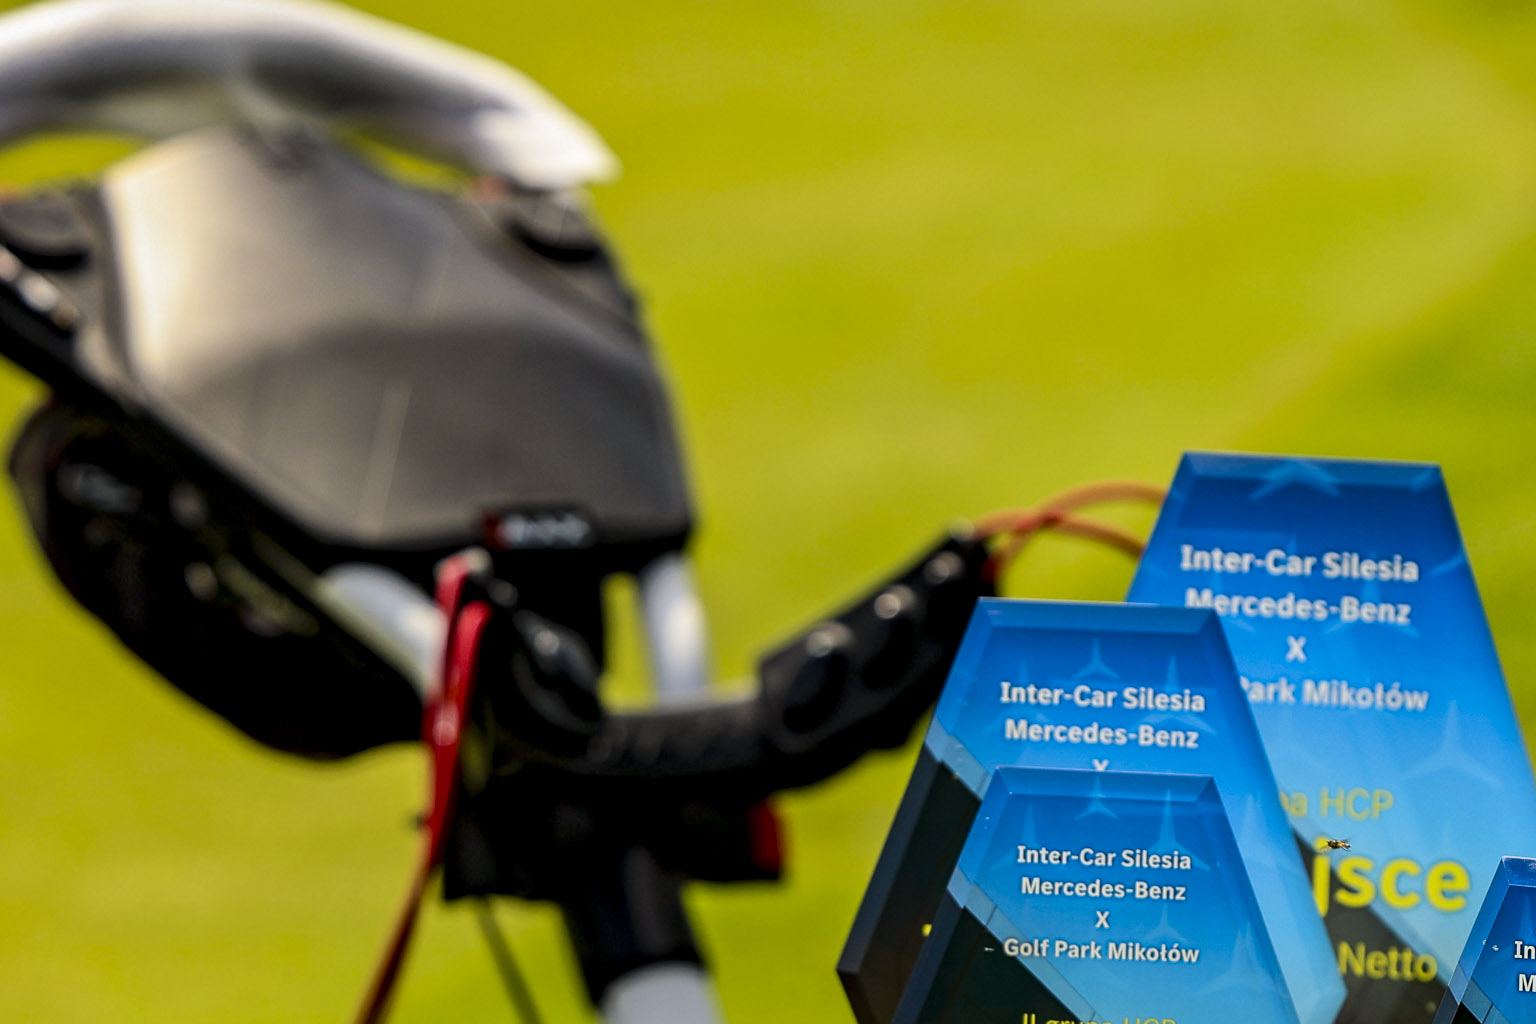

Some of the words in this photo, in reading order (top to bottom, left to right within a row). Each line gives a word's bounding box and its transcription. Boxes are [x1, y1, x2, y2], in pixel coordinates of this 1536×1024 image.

[1181, 545, 1316, 577] Inter-Car
[1322, 553, 1419, 583] Silesia
[1185, 588, 1411, 625] Mercedes-Benz
[1286, 636, 1307, 662] X
[1001, 681, 1118, 708] Inter-Car
[1123, 687, 1206, 712] Silesia
[1302, 679, 1429, 711] Mikołów
[1005, 718, 1199, 749] Mercedes-Benz
[1320, 788, 1394, 820] HCP
[1017, 845, 1116, 867] Inter-Car
[1121, 850, 1192, 870] Silesia
[1021, 876, 1187, 900] Mercedes-Benz
[1313, 836, 1470, 917] jsce
[1095, 911, 1110, 928] X
[1004, 938, 1050, 957] Golf
[1055, 940, 1102, 959] Park
[1108, 942, 1200, 963] Mikołów
[1338, 941, 1438, 982] Netto
